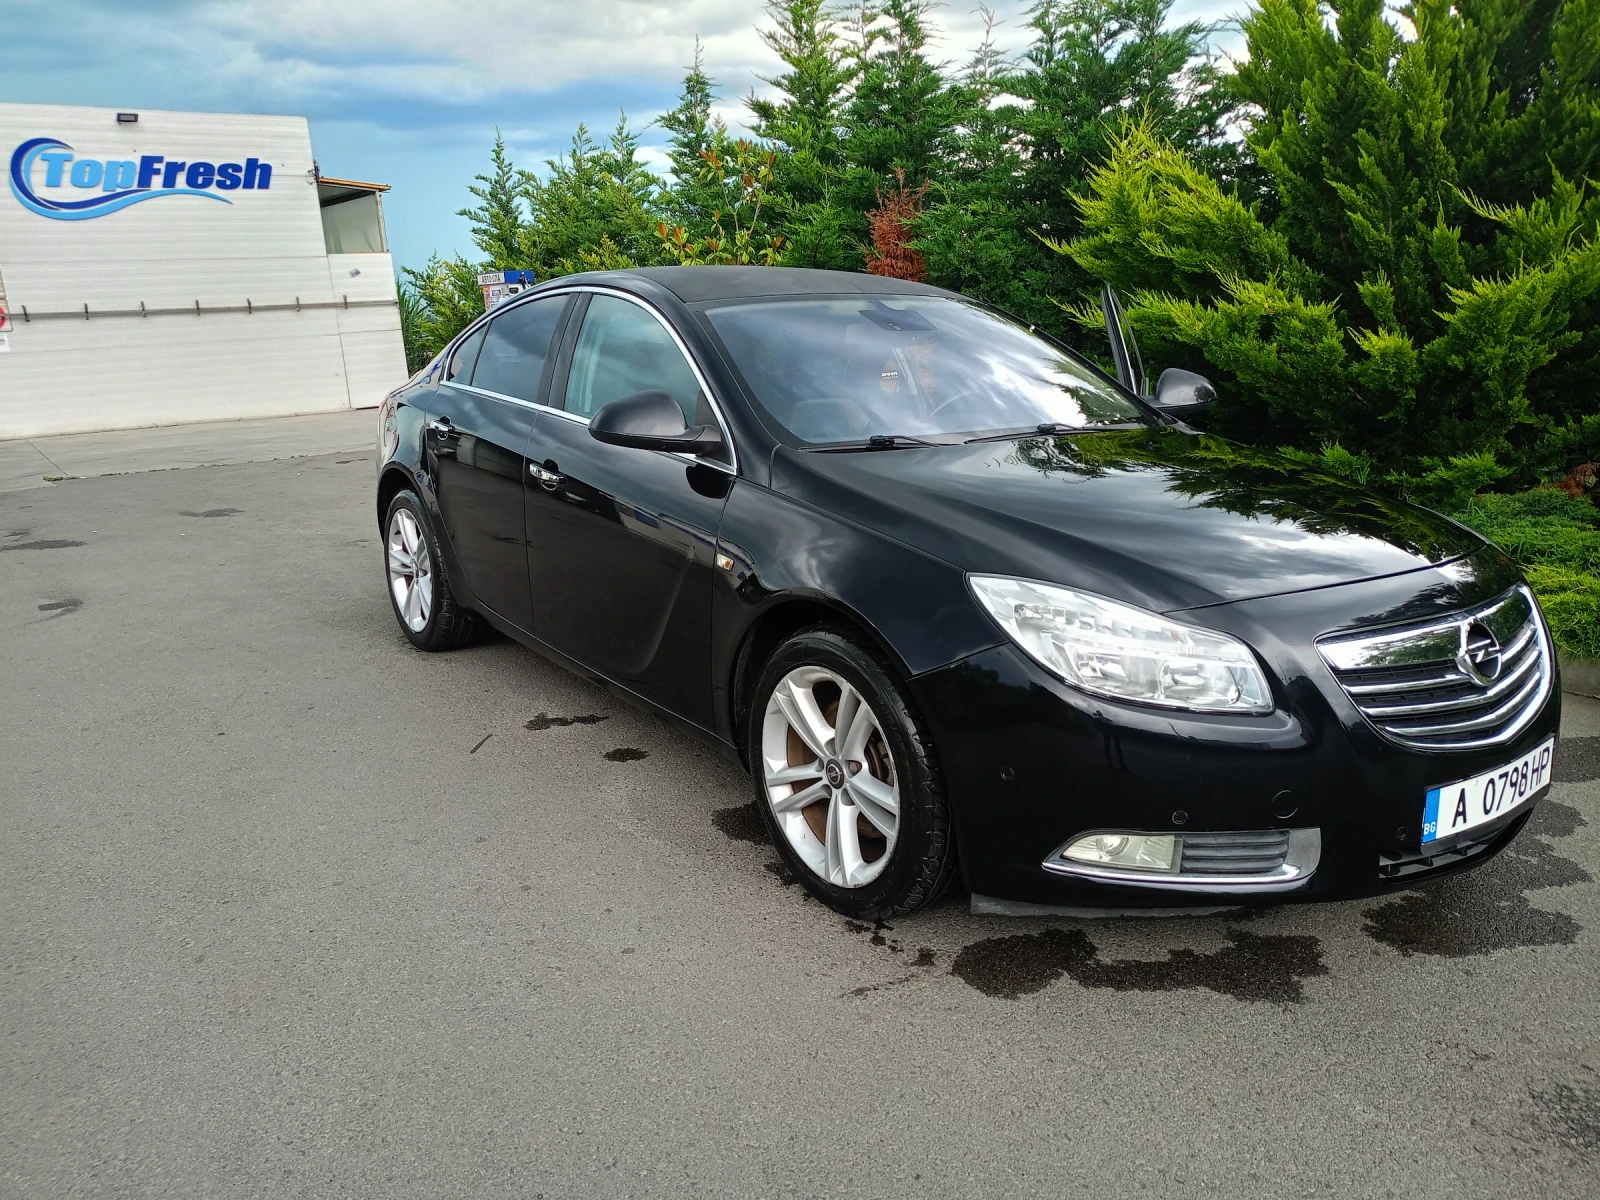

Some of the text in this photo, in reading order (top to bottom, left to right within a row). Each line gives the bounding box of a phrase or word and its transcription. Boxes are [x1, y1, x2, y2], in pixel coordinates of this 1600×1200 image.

[40, 153, 273, 192] TopFresh
[1452, 787, 1468, 828] A
[1483, 760, 1529, 815] 0798
[1423, 822, 1437, 834] BG
